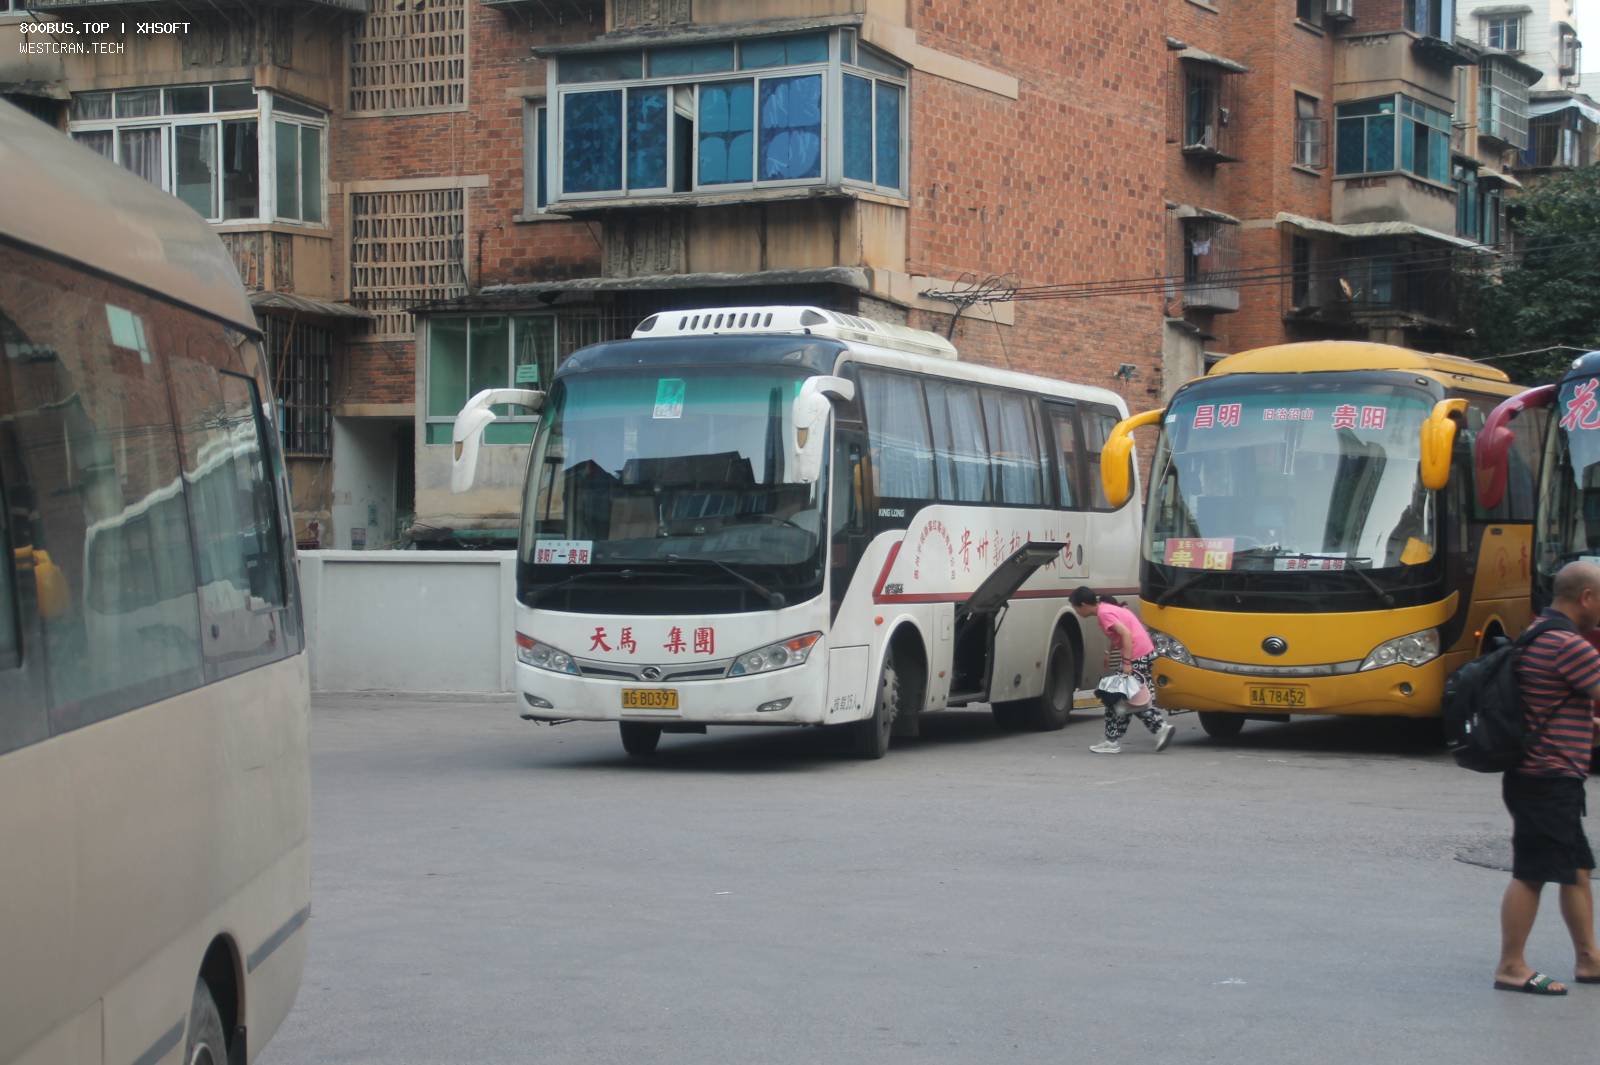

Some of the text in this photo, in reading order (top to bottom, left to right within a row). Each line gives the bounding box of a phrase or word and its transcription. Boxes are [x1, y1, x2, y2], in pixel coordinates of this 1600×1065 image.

[1192, 403, 1242, 430] 昌明
[1332, 404, 1388, 430] 贵阳
[878, 508, 905, 518] KING LONG
[589, 625, 715, 656] 天馬 集團
